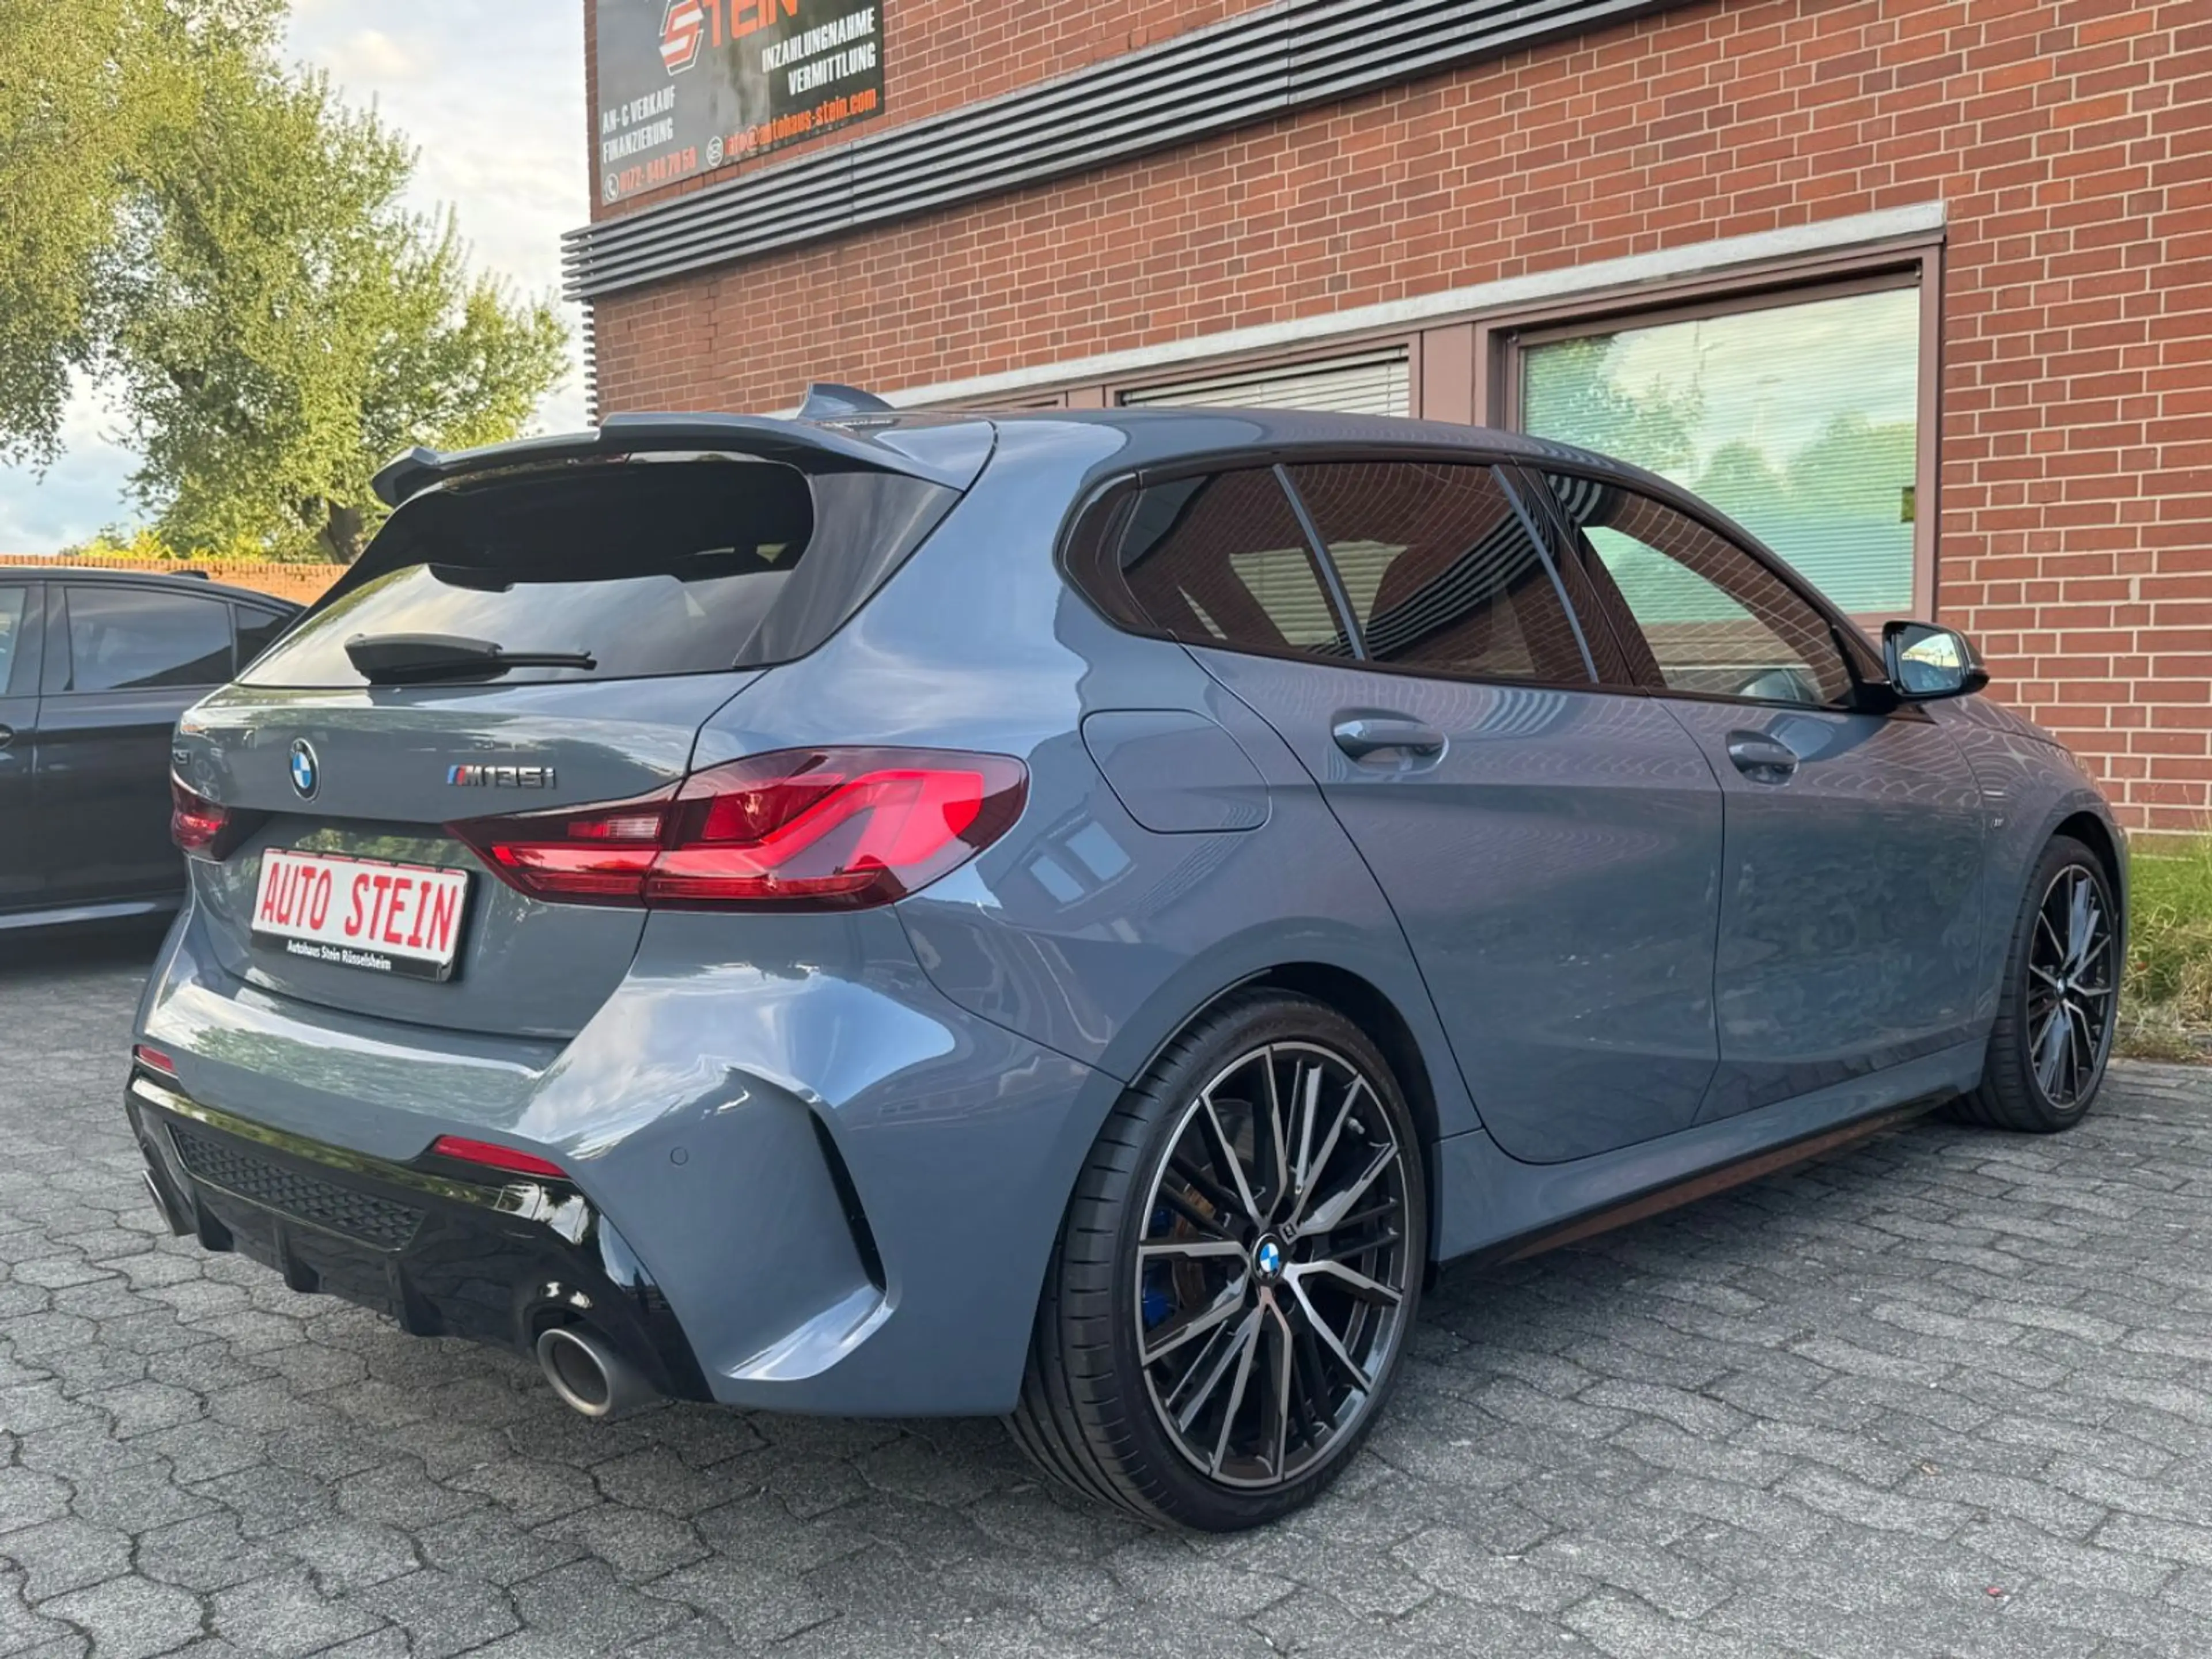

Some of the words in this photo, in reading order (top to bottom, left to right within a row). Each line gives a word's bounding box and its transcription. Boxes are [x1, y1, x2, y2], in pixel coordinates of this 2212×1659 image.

[762, 6, 875, 73] INZAHLUNGNAHME
[788, 42, 876, 96] VERMITTLUNG
[630, 85, 676, 124] VERKAUF
[603, 116, 673, 164] FINANZIERUNG
[461, 764, 556, 789] M135i
[260, 862, 332, 930] AUTO
[344, 873, 457, 952] STEIN
[287, 940, 320, 957] Autohaus
[321, 945, 340, 962] Stein
[342, 949, 391, 971] Rüsselsheim
